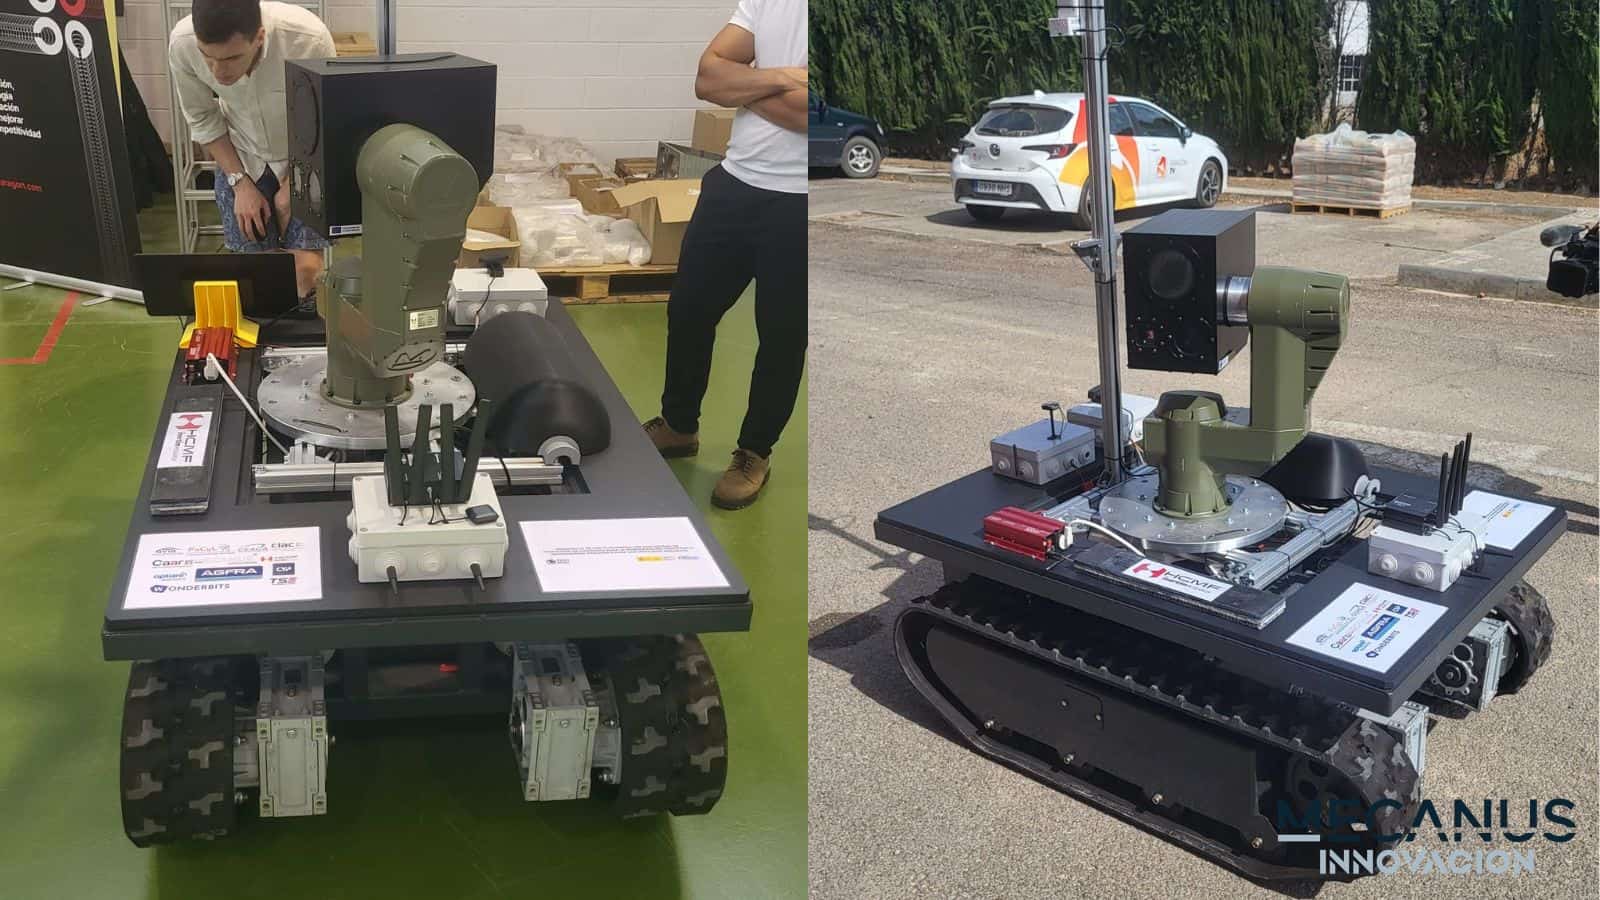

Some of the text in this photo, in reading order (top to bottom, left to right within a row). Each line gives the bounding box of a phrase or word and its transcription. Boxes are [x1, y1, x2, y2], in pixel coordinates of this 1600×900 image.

[184, 430, 197, 462] HCMF
[200, 567, 258, 578] AGFRA
[1164, 571, 1221, 590] HCMF
